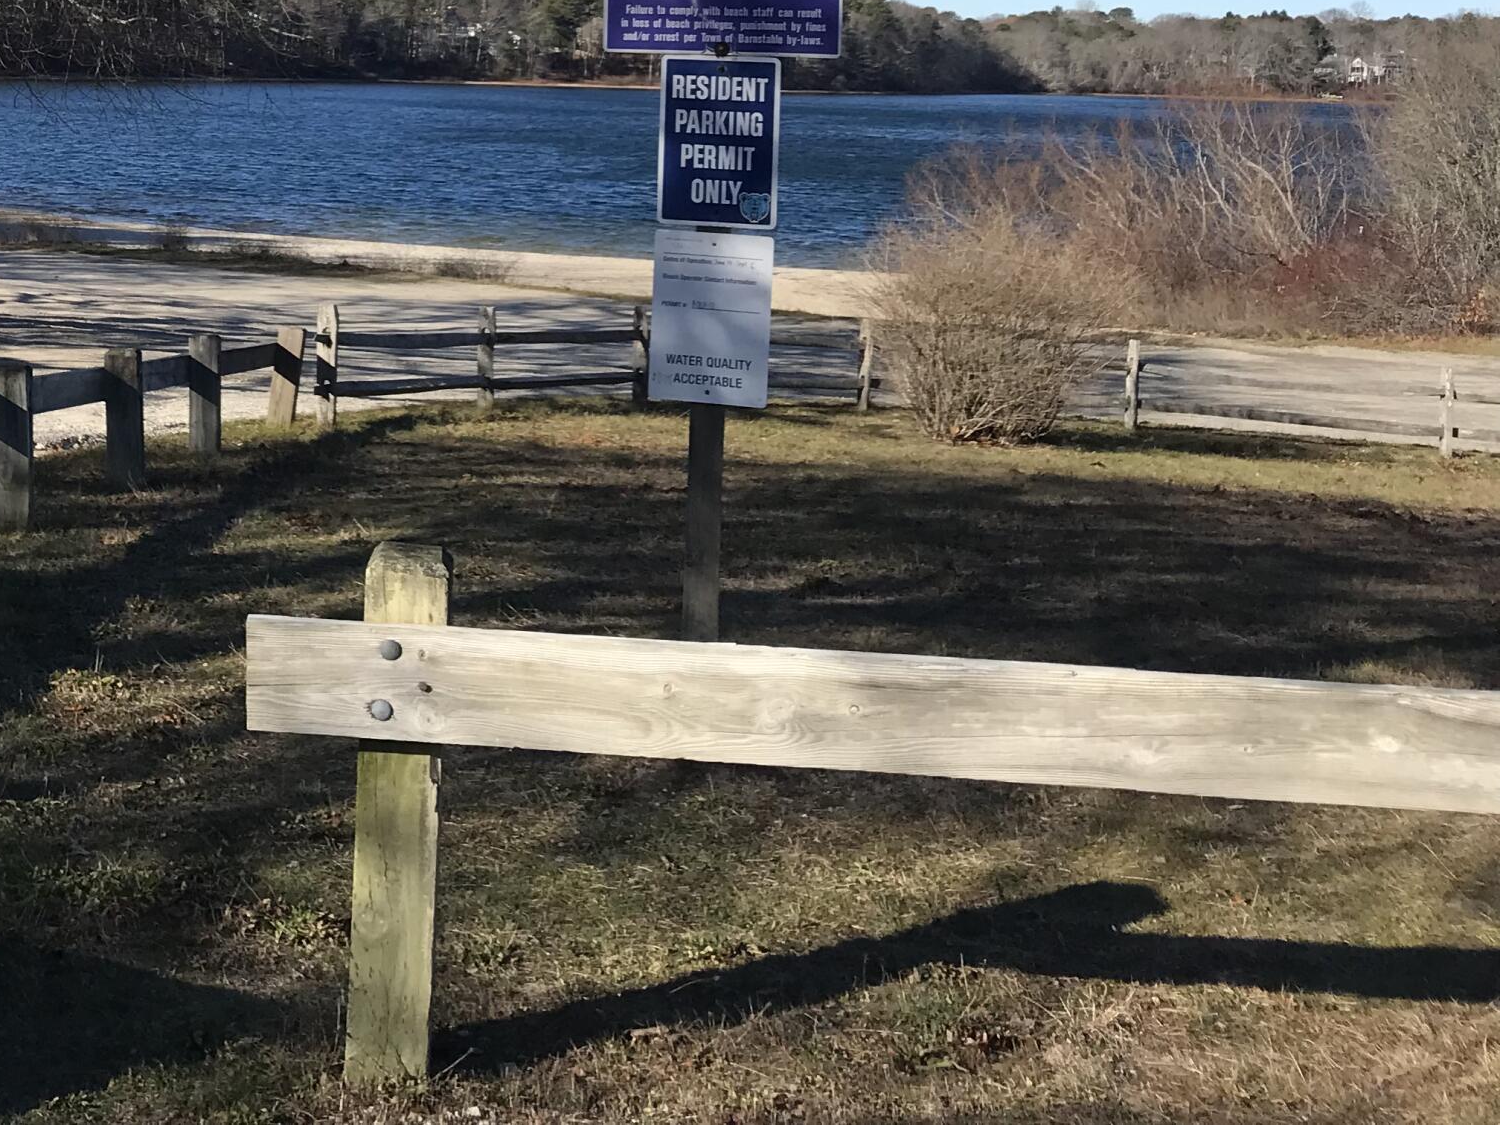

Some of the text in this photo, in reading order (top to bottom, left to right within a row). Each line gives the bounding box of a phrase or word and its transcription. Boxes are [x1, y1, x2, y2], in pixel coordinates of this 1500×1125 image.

[626, 4, 653, 14] Failure
[657, 5, 665, 15] to
[669, 6, 698, 17] comply
[703, 6, 720, 16] with
[753, 8, 774, 17] staff
[798, 9, 821, 18] result
[621, 18, 628, 27] in
[633, 18, 649, 27] loss
[653, 19, 662, 27] of
[666, 19, 690, 28] beach
[791, 22, 801, 33] by
[806, 22, 826, 31] fines
[623, 31, 650, 41] and/or
[654, 32, 679, 41] arrest
[684, 35, 697, 43] per
[701, 33, 721, 42] Town
[725, 34, 733, 42] of
[738, 34, 783, 44] Barnstable
[672, 75, 769, 102] RESIDENT
[675, 109, 763, 137] PARKING
[680, 144, 755, 171] PERMIT
[691, 179, 742, 205] ONLY
[666, 354, 752, 370] WATER QUALITY
[673, 373, 743, 389] ACCEPTABLE
